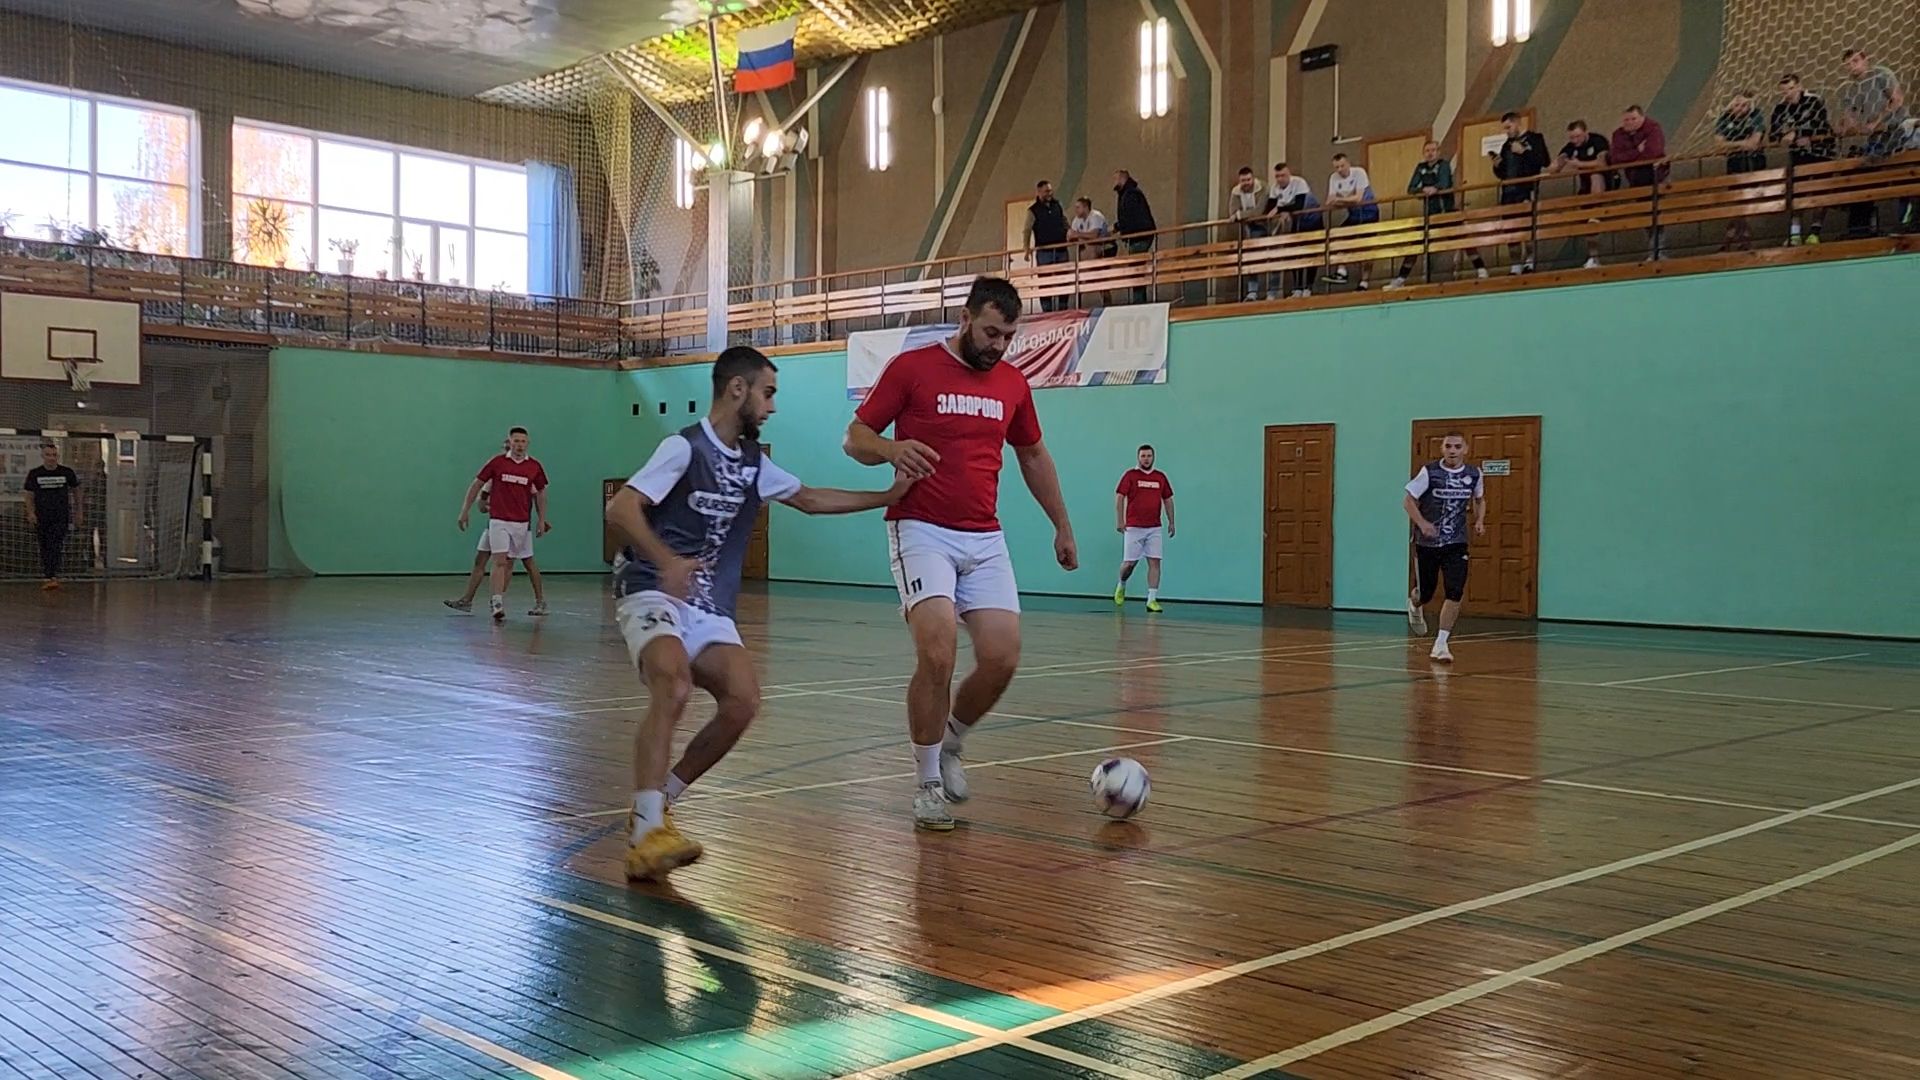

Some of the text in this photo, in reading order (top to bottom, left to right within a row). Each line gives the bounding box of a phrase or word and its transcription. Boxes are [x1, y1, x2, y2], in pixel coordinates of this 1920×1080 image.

[1030, 319, 1090, 349] ОБЛАСТИ
[937, 393, 1003, 421] ЗАВОРОВО
[911, 578, 922, 594] 11
